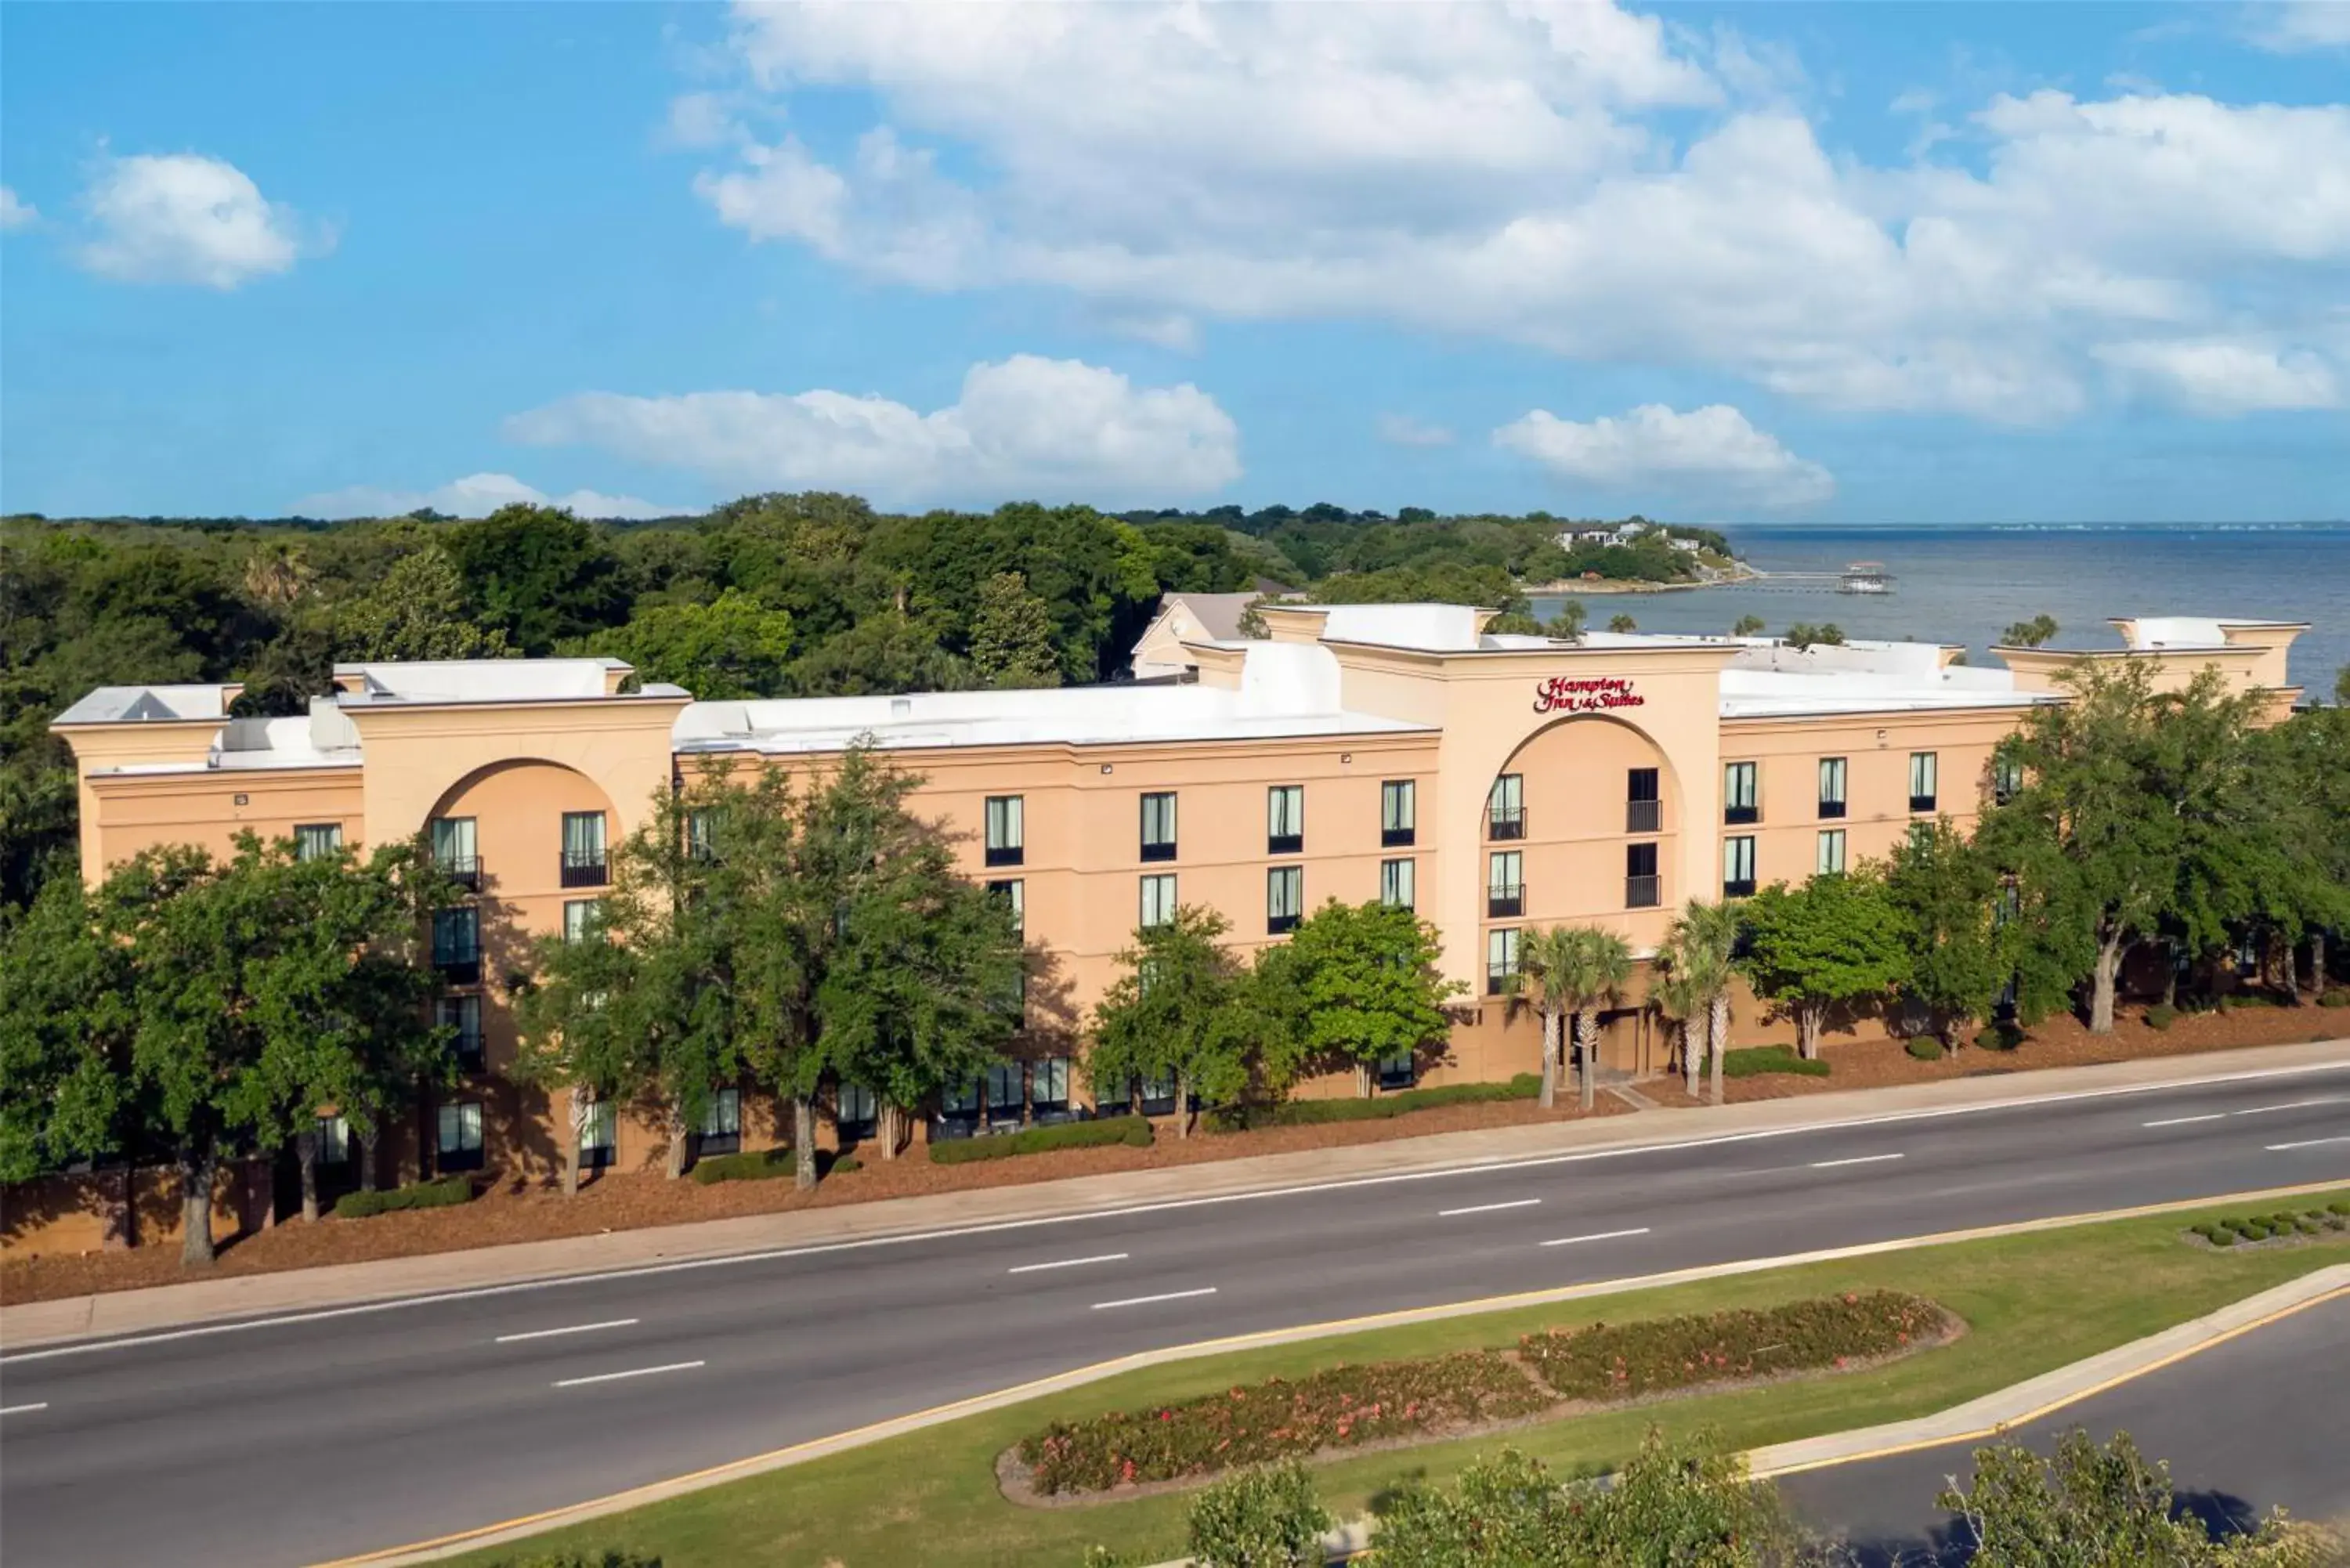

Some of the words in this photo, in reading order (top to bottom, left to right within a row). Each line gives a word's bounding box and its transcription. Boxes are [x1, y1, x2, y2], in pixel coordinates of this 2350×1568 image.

[1537, 677, 1633, 698] Hampton
[1534, 695, 1582, 714] Inn
[1582, 698, 1596, 711] &
[1594, 692, 1644, 709] Suites
